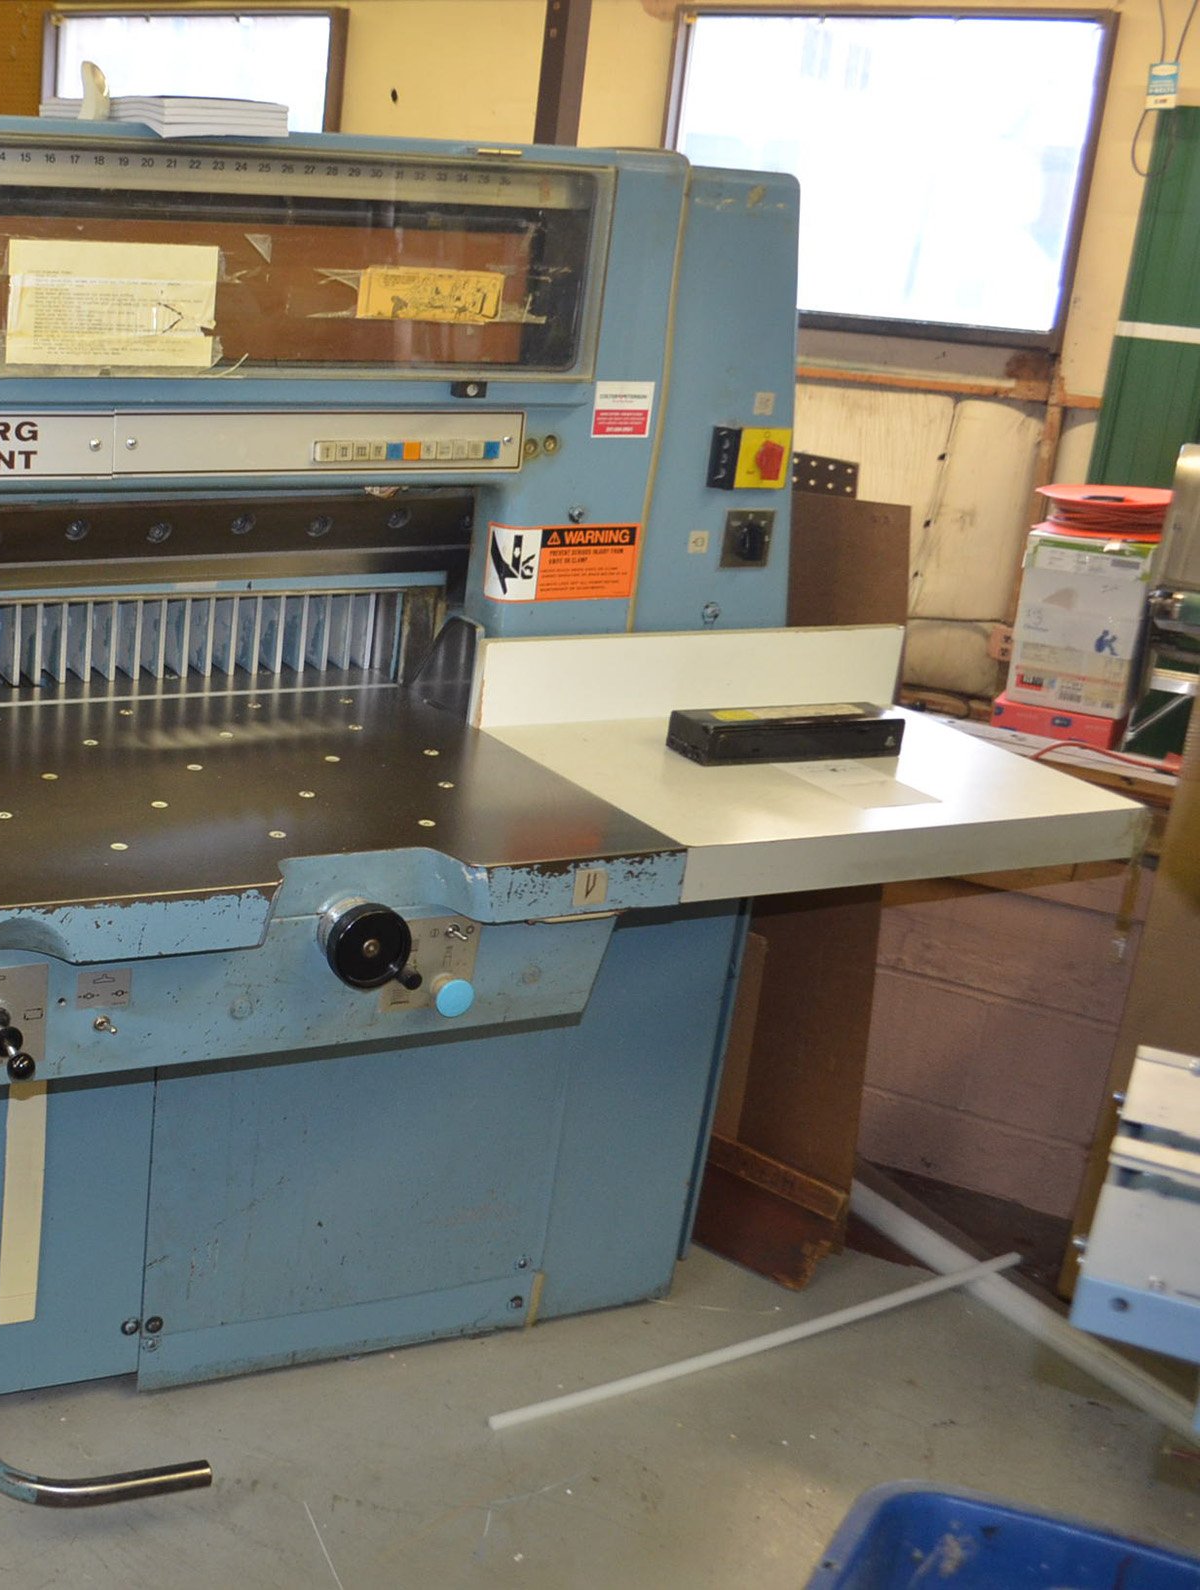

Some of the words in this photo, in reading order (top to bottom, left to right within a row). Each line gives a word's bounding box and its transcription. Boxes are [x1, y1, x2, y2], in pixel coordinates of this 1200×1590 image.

[20, 153, 31, 162] 15
[45, 153, 56, 163] 16
[70, 154, 80, 164] 17
[94, 155, 105, 165] 18
[118, 156, 129, 166] 19
[141, 157, 154, 167] 20
[166, 158, 177, 168] 21
[189, 159, 200, 169] 22
[212, 160, 225, 170] 23
[235, 162, 247, 172] 24
[258, 162, 271, 173] 25
[281, 164, 294, 174] 26
[304, 165, 316, 174] 27
[326, 166, 338, 176] 28
[349, 167, 361, 177] 29
[564, 529, 630, 544] WARNING
